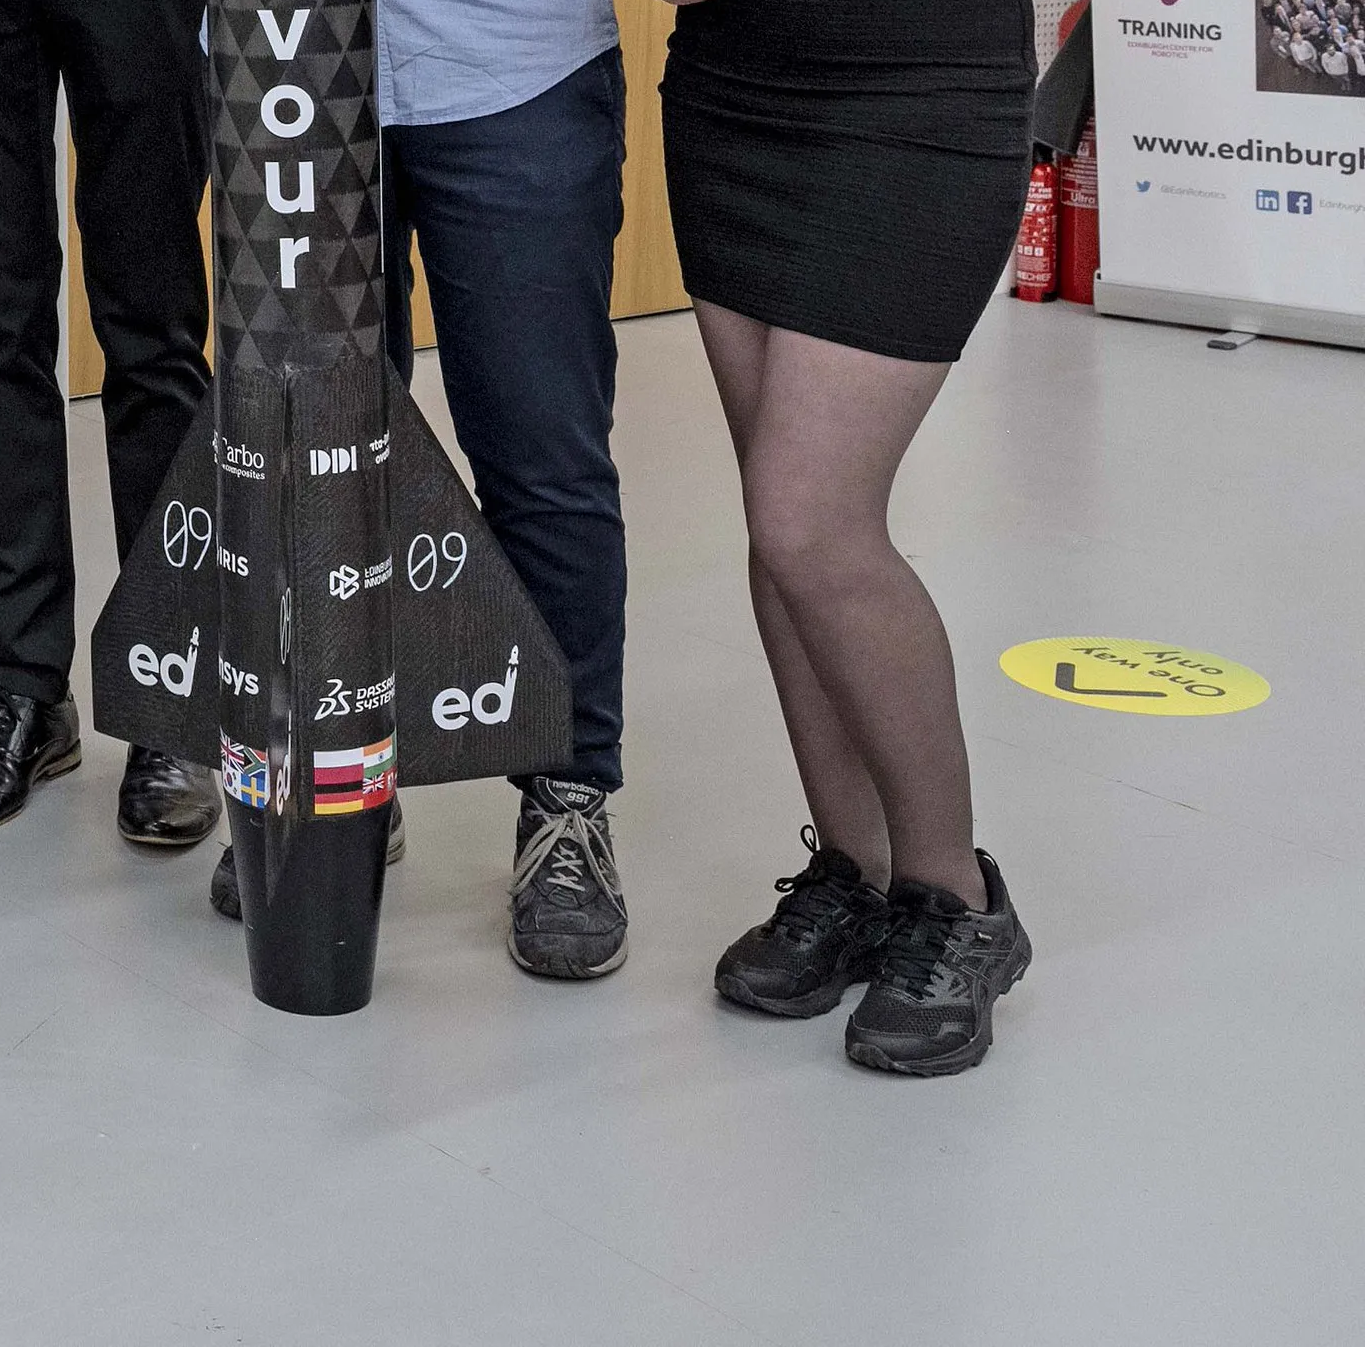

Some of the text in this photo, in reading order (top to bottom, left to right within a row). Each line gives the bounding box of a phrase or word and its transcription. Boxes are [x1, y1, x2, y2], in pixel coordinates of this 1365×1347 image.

[1118, 19, 1222, 41] TRAINING
[1127, 41, 1213, 53] EDINBURGH CENTRE FOR
[1151, 50, 1188, 59] ROBOTICS
[1070, 192, 1096, 204] Ultra
[163, 500, 212, 571] 09
[407, 531, 467, 592] 09
[218, 654, 259, 696] nsys
[1072, 647, 1226, 697] One way
[1144, 651, 1224, 675] only
